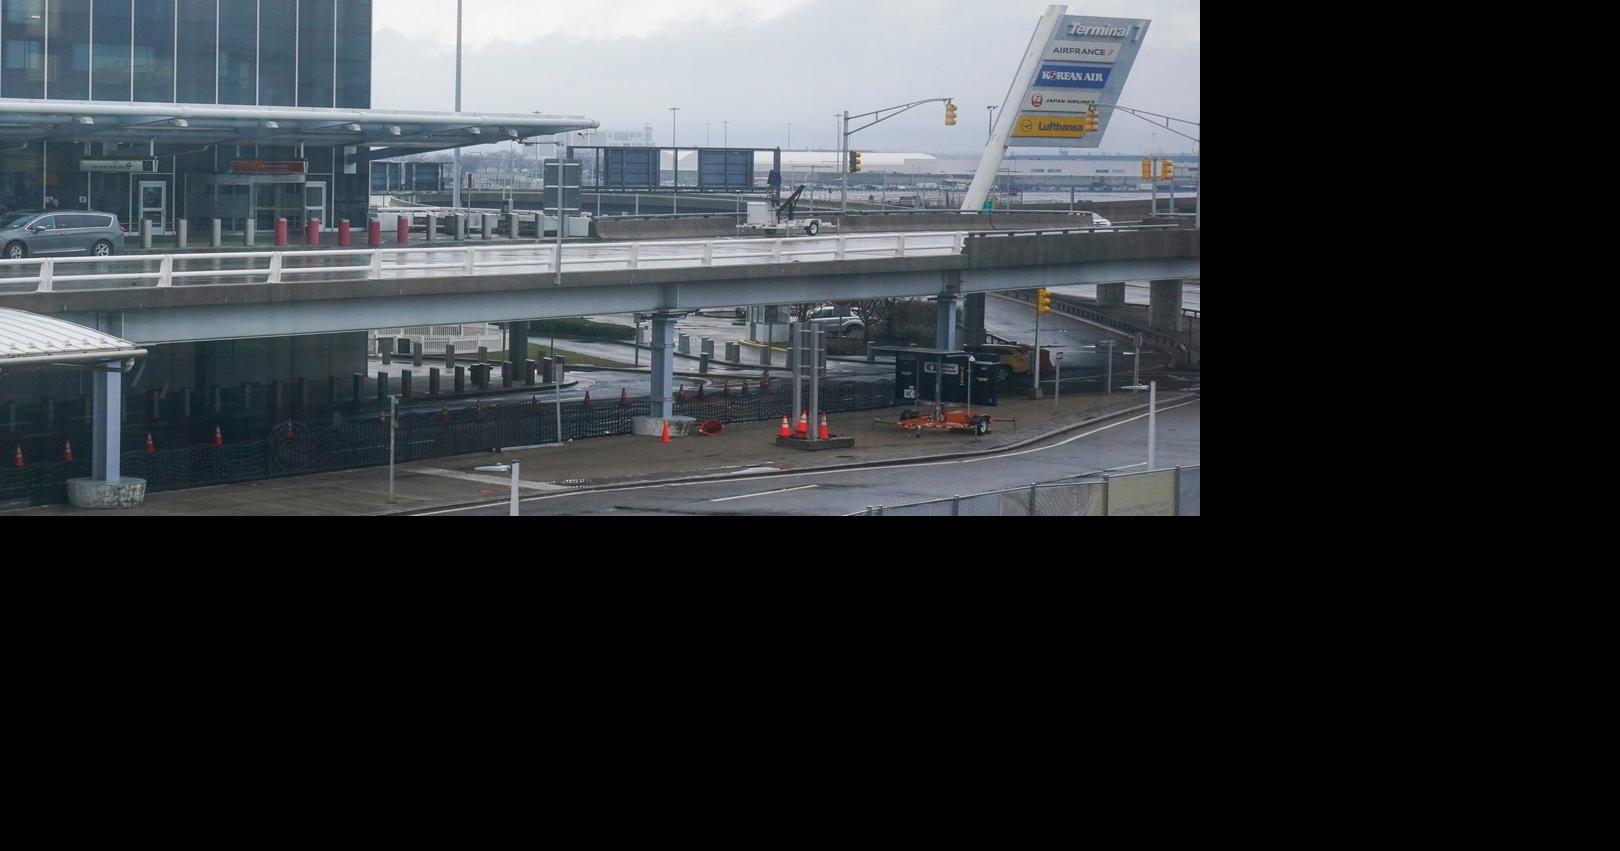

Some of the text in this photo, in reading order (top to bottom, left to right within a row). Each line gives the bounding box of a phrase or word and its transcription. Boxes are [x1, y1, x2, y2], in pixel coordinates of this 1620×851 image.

[1068, 23, 1143, 42] Terminal 1
[1041, 71, 1104, 82] KOREAN AIR
[1038, 121, 1084, 132] Lufthansa
